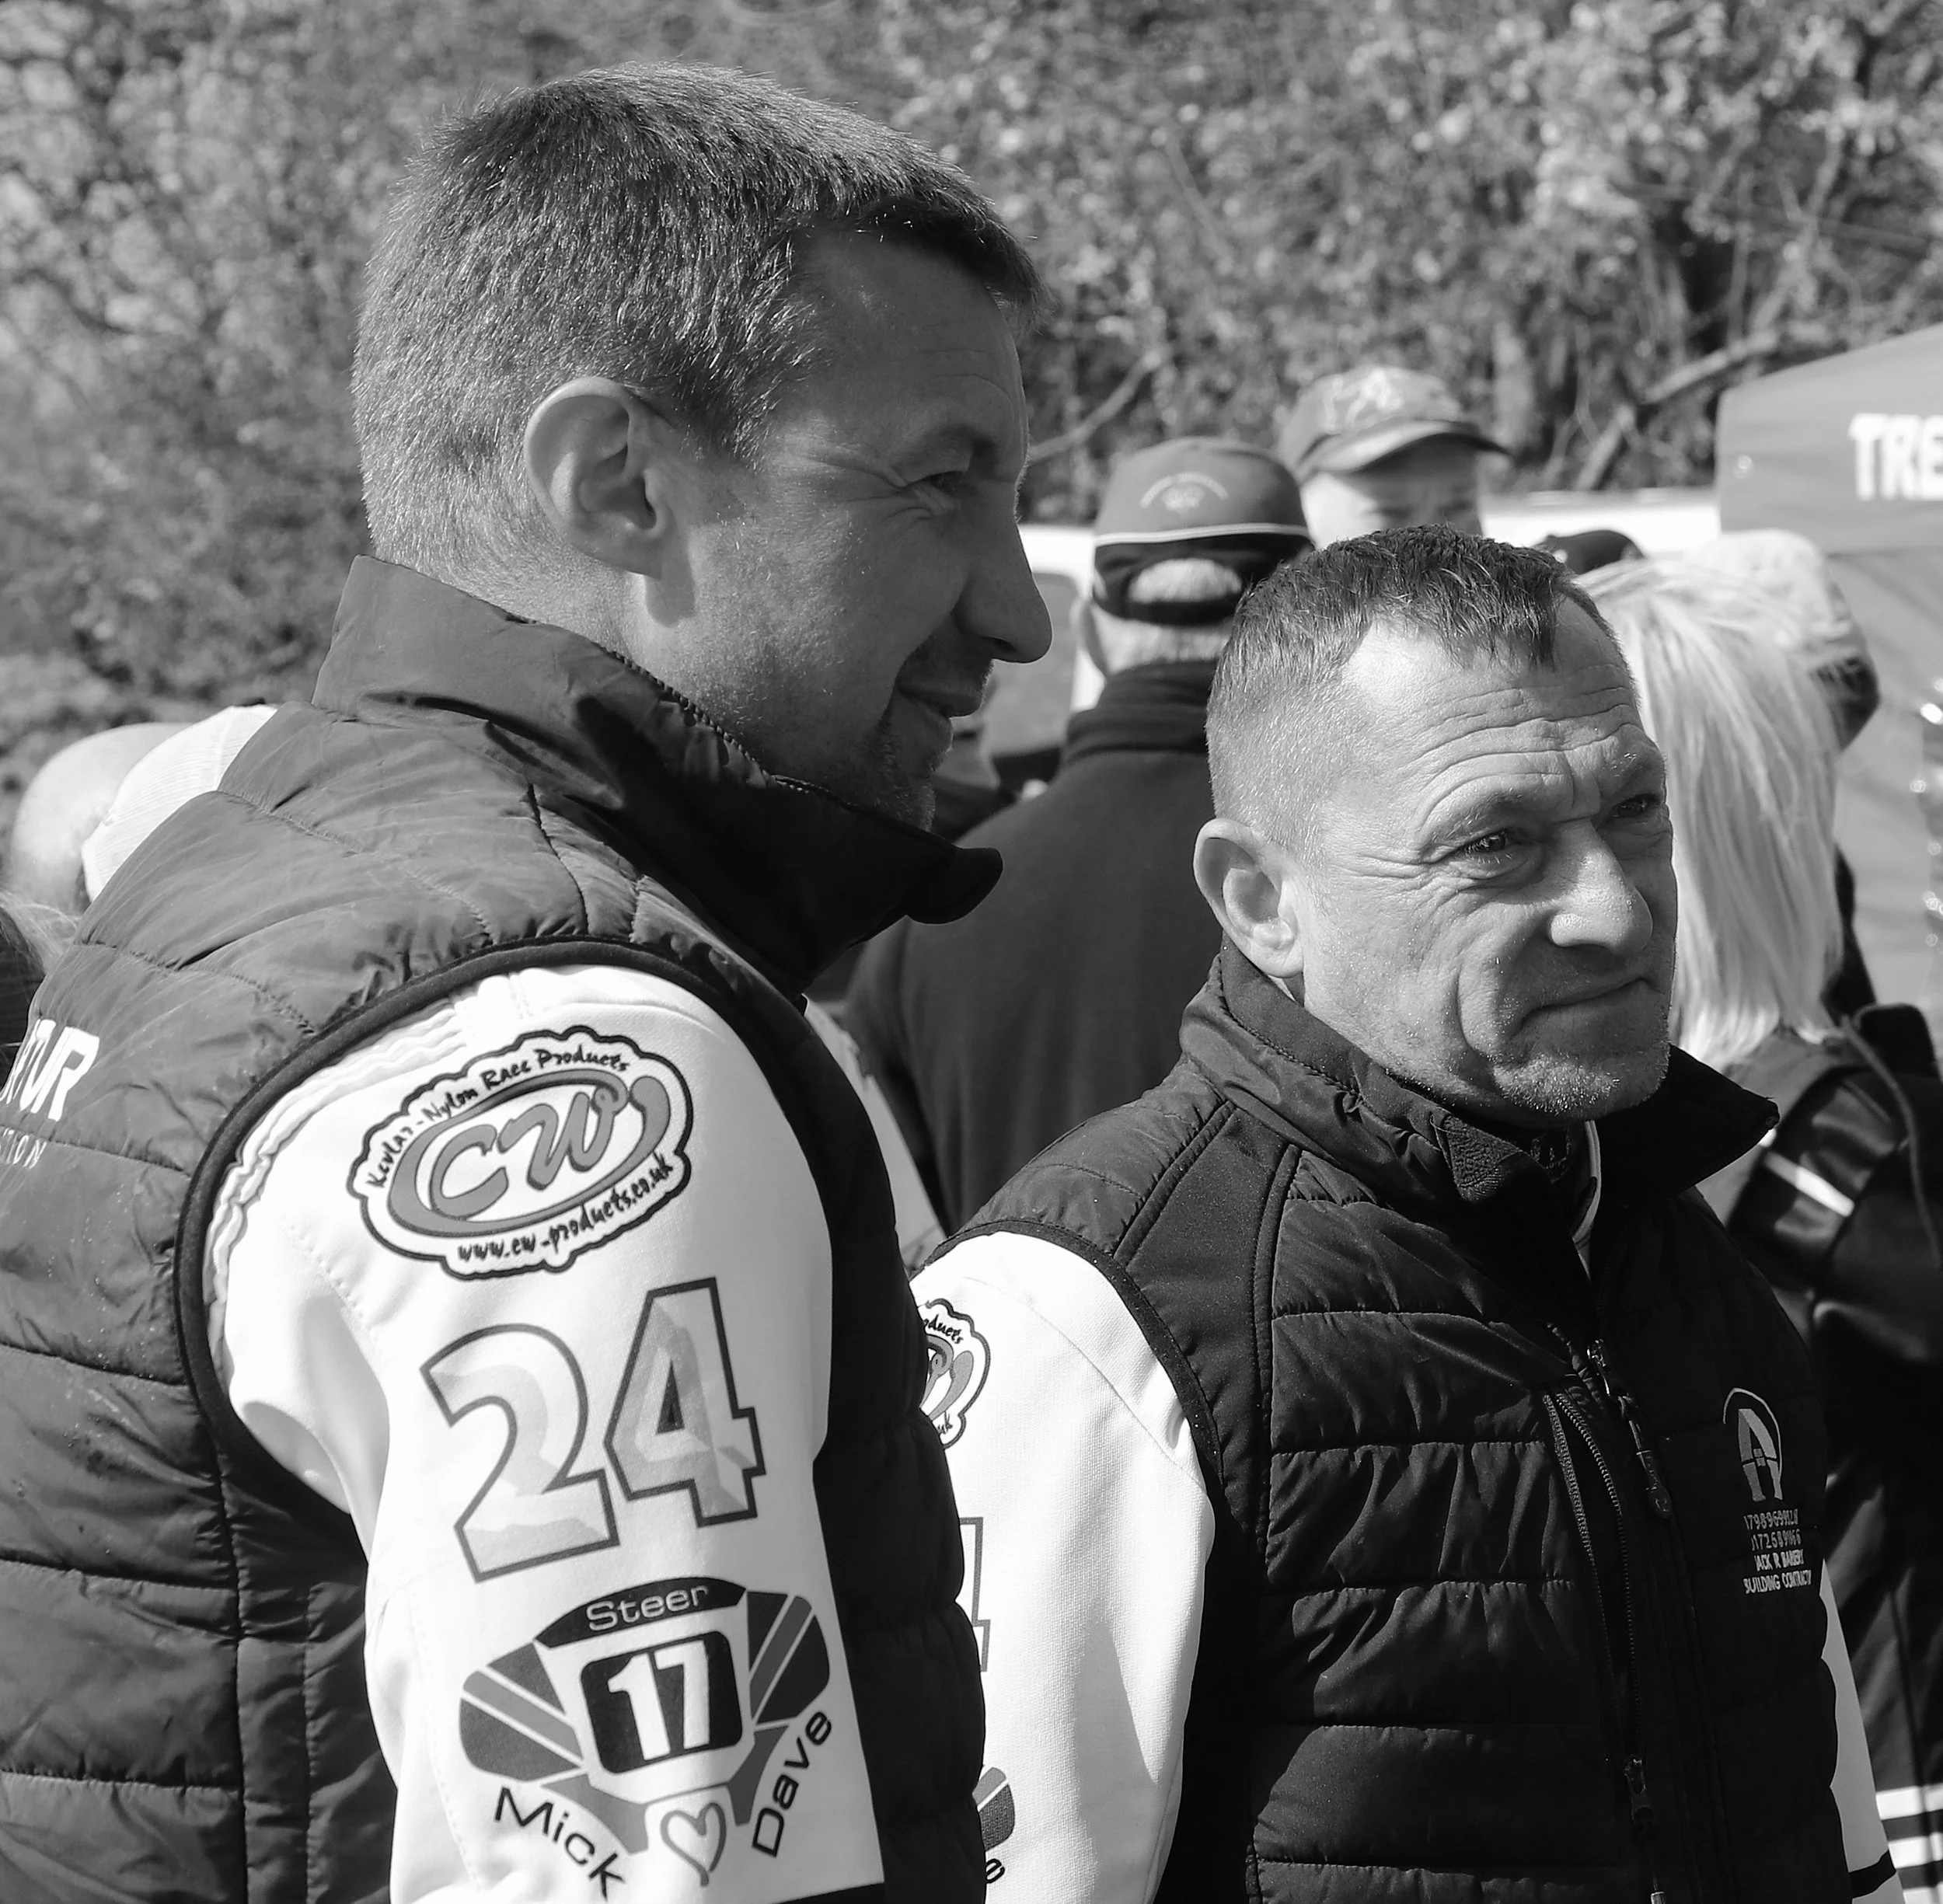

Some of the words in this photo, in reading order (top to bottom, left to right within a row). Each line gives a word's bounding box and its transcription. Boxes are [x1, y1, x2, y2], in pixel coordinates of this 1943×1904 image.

[365, 1125, 413, 1188] Kevlar
[420, 1089, 479, 1119] Nylon
[480, 1060, 532, 1090] Race
[533, 1044, 630, 1072] Products
[418, 1276, 767, 1583] 24
[585, 1584, 710, 1633] Steer
[606, 1640, 710, 1762] 17
[493, 1787, 626, 1901] Mick
[751, 1710, 832, 1858] Dave
